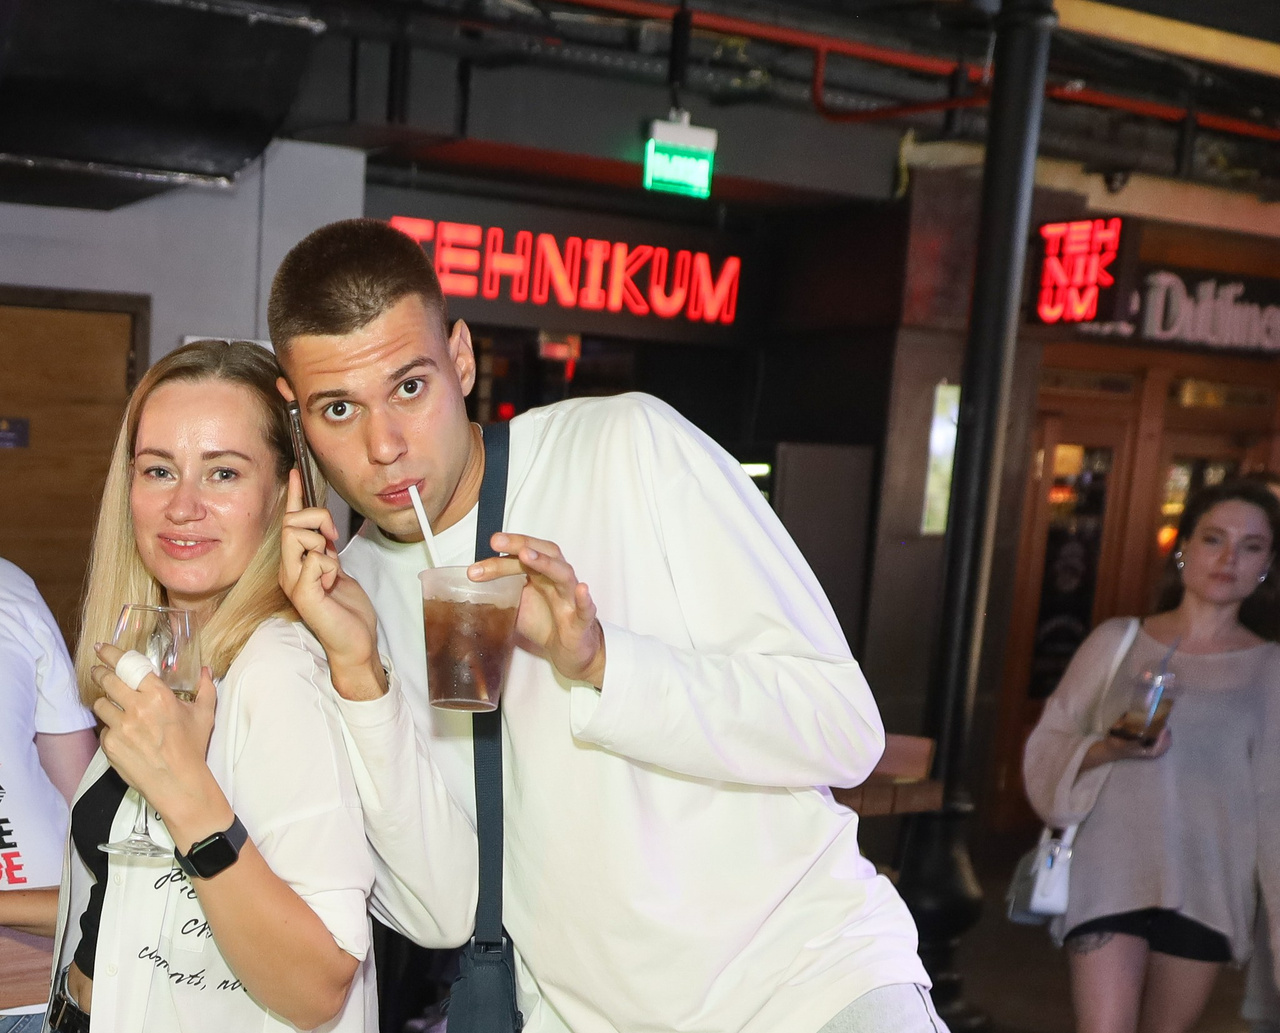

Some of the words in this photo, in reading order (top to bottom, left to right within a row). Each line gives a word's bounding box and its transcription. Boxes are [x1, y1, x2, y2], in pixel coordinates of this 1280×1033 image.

[1040, 217, 1122, 256] TEH
[1040, 251, 1117, 288] NIK
[1037, 286, 1099, 324] UM
